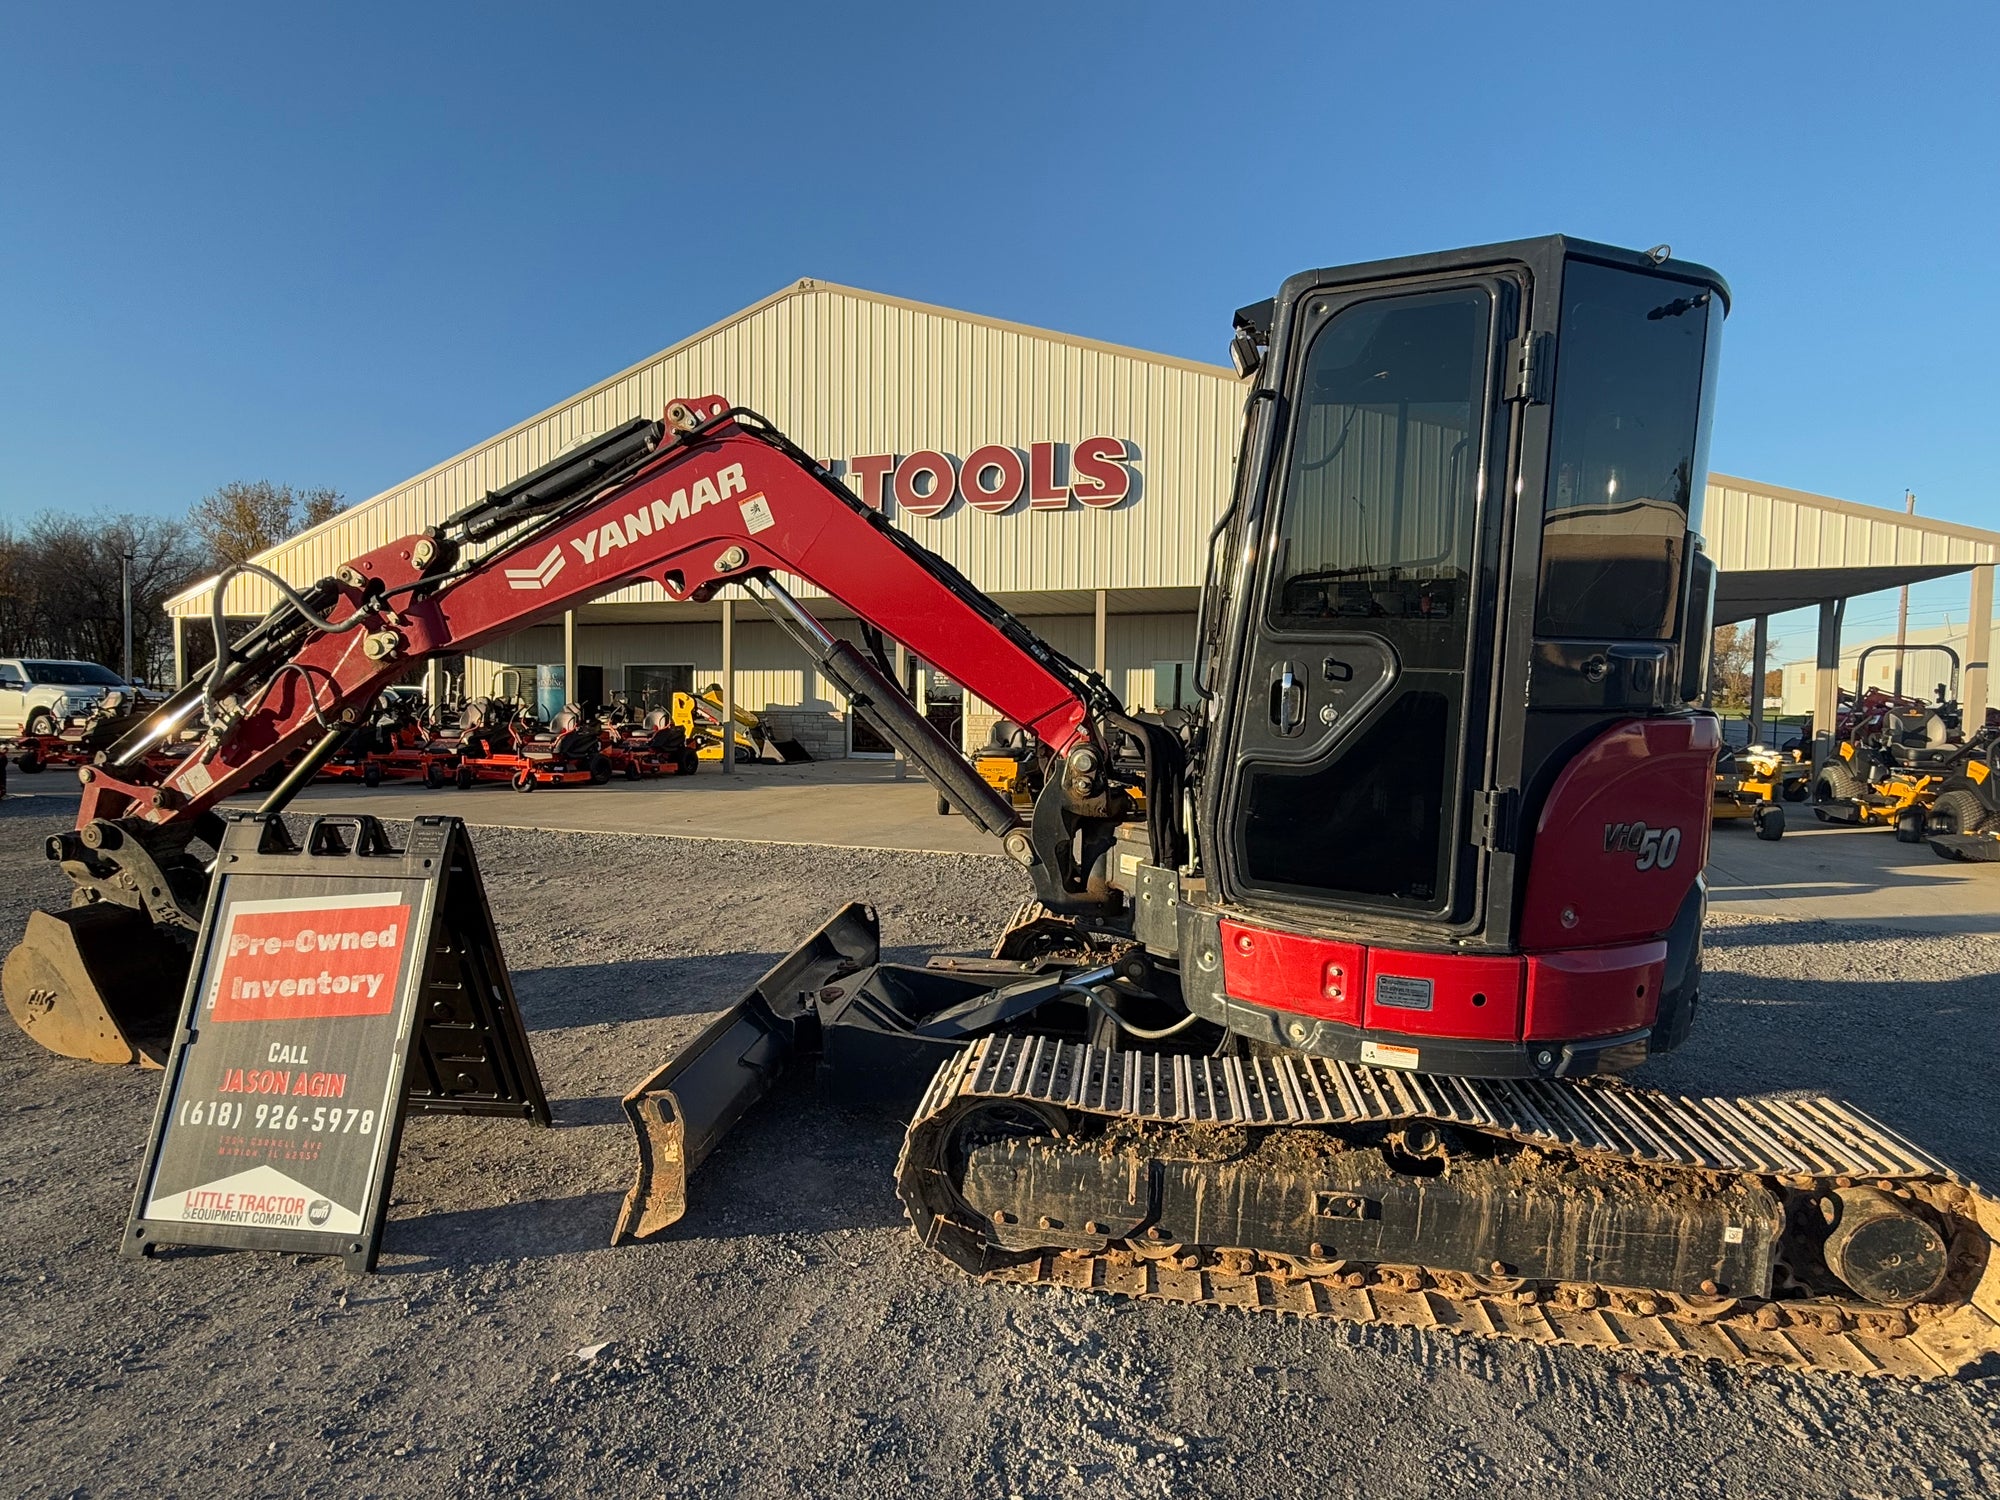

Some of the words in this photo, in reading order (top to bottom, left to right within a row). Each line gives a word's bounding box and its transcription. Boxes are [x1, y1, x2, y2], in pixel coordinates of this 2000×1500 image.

[850, 435, 1130, 518] TOOLS
[570, 462, 748, 565] YANMAR
[229, 924, 398, 957] Pre-Owned
[231, 971, 385, 1000] Inventory
[219, 1068, 290, 1095] JASON
[292, 1071, 347, 1098] AGIN
[179, 1100, 242, 1129] (618)
[255, 1103, 375, 1135] 926-5978
[186, 1191, 235, 1210] LITTLE
[238, 1194, 306, 1215] TRACTOR
[252, 1211, 302, 1227] COMPANY
